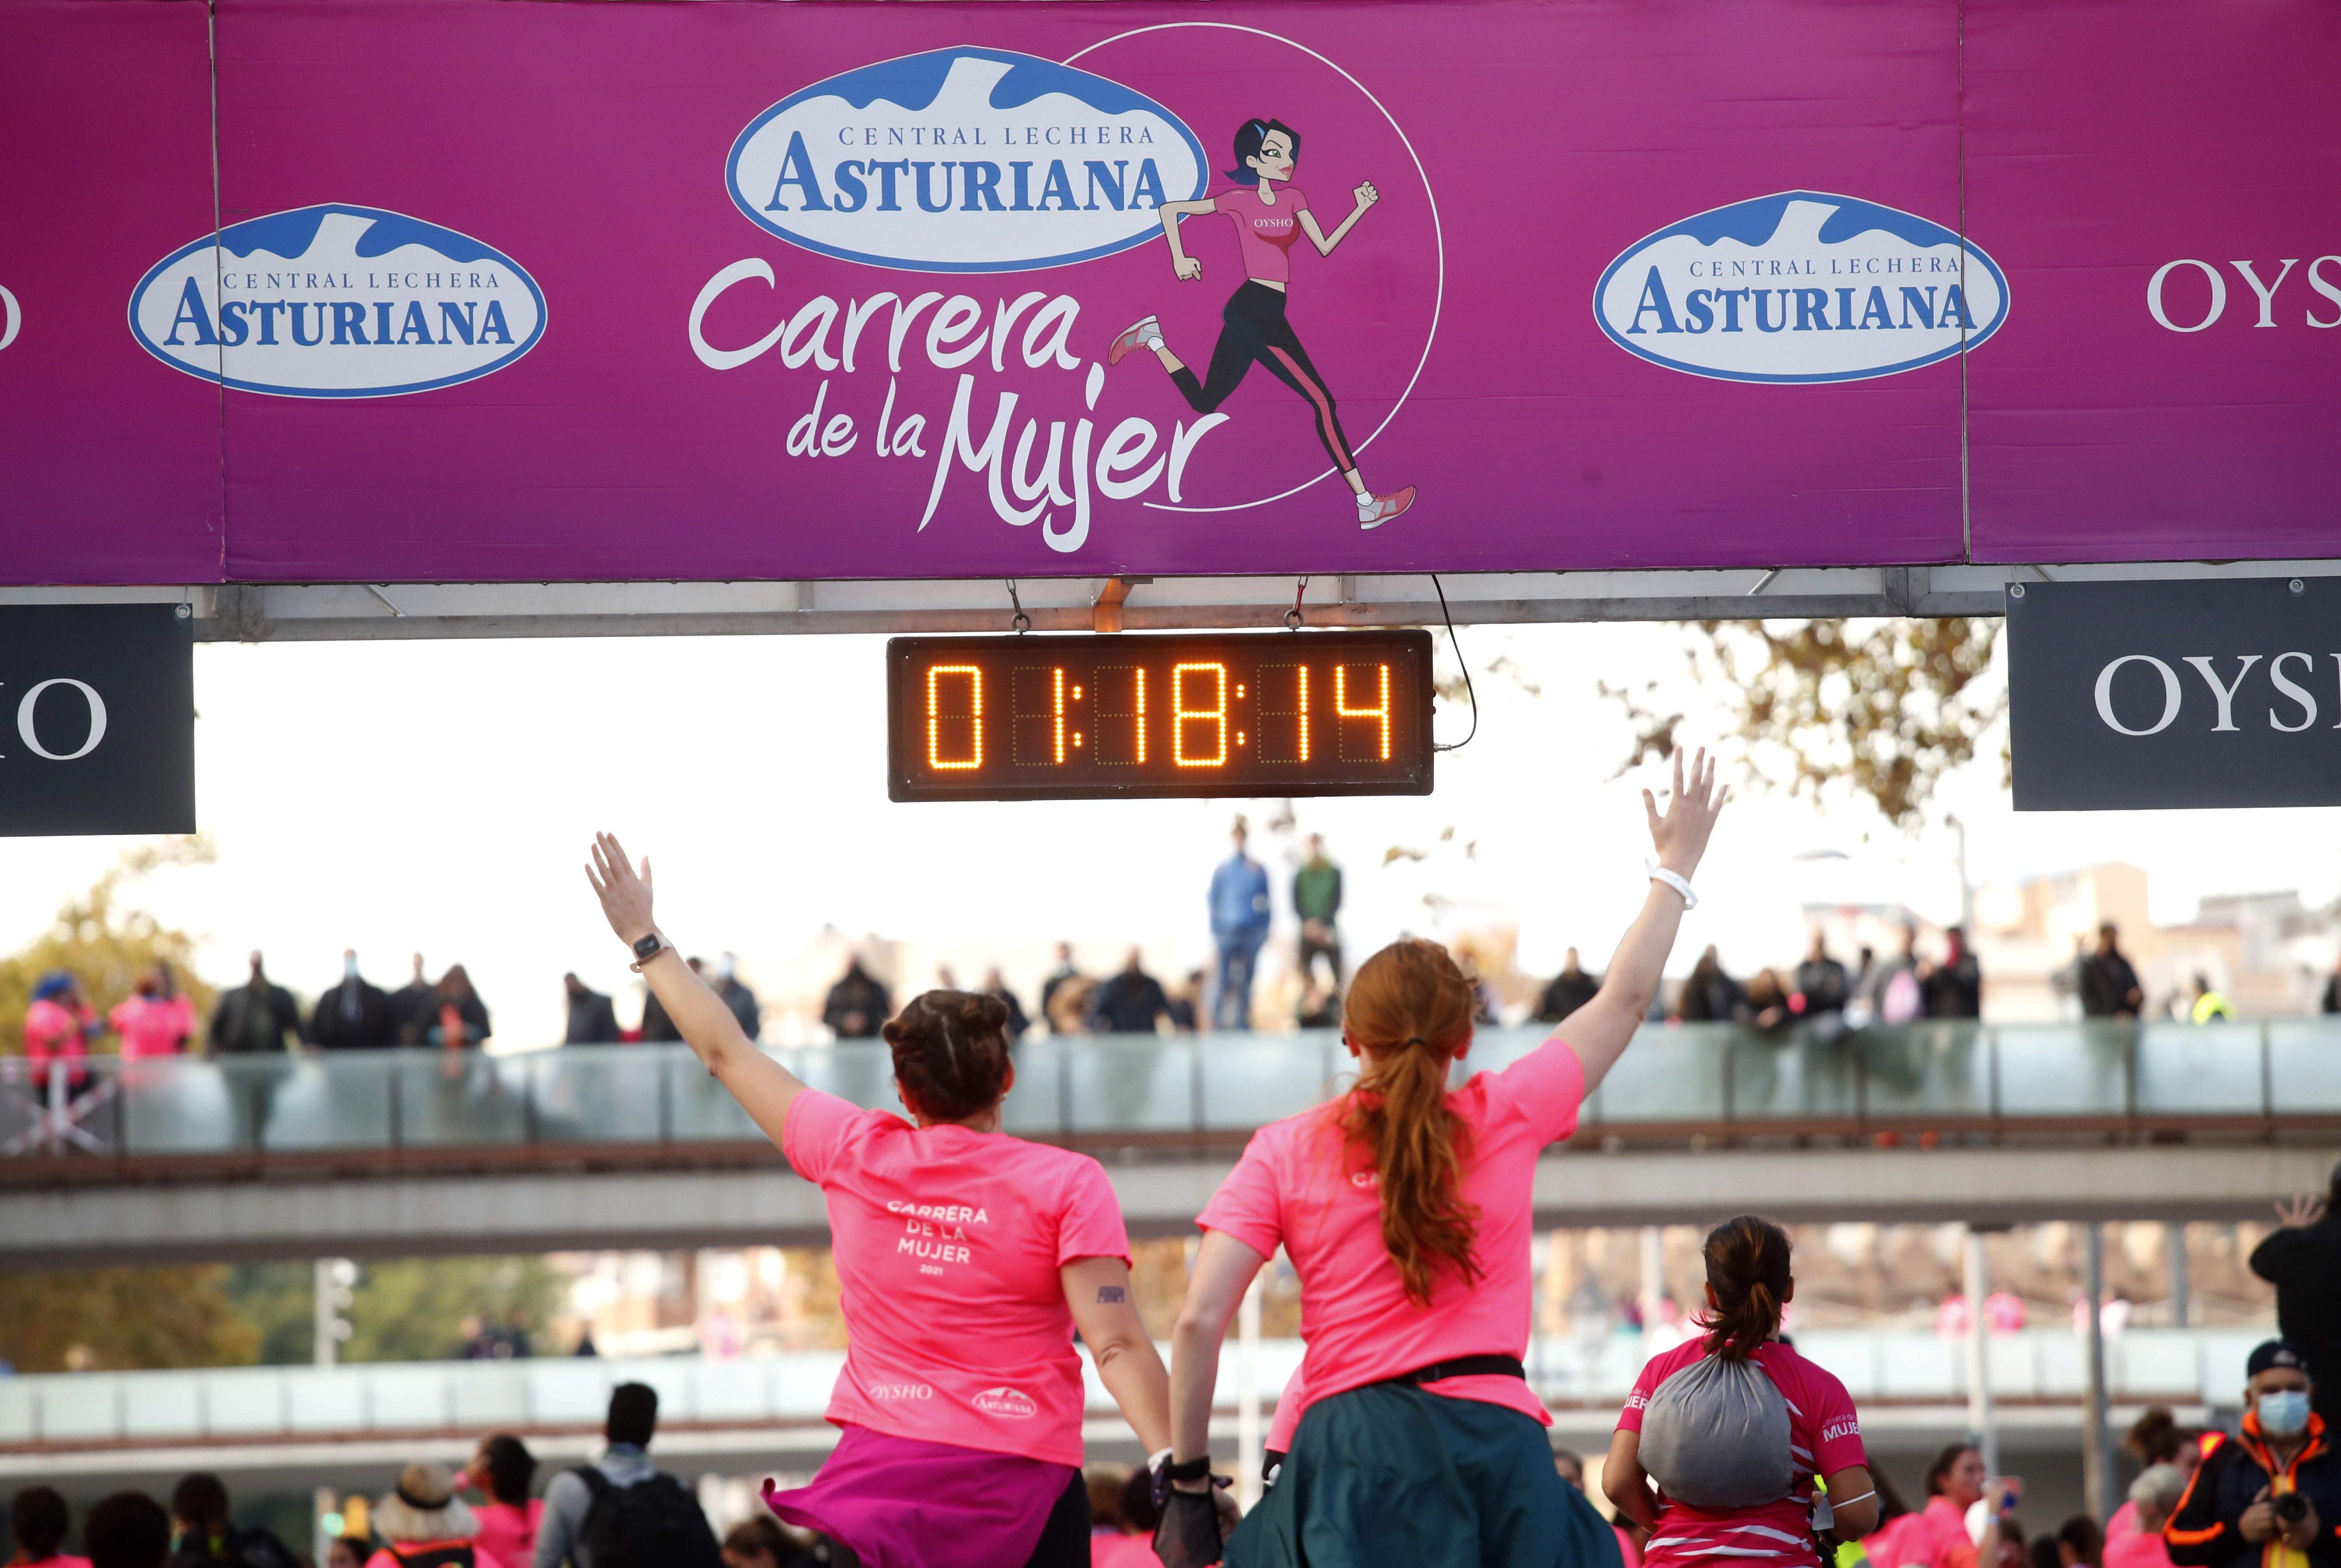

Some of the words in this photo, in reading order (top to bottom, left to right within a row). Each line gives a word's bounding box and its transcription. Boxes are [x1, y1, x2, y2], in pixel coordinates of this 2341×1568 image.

[839, 127, 986, 145] CENTRAL
[1005, 127, 1154, 144] LECHERA
[764, 130, 1161, 213] ASTURIANA
[1254, 218, 1293, 228] OYSHO
[1690, 259, 1816, 276] CENTRAL
[1831, 257, 1960, 274] LECHERA
[224, 273, 354, 289] CENTRAL
[369, 272, 500, 288] LECHERA
[163, 276, 515, 346] ASTURIANA
[1626, 265, 1977, 334] ASTURIANA
[689, 257, 1081, 373] Carrera
[787, 379, 858, 457] de
[876, 376, 926, 457] la
[917, 362, 1230, 553] Mujer
[2095, 652, 2341, 736] OYS
[927, 661, 1391, 770] 01:18:14
[887, 1200, 989, 1224] CARRERA
[906, 1218, 933, 1237] DE
[940, 1226, 967, 1242] LA
[898, 1237, 971, 1264] MUJER
[919, 1264, 944, 1275] 2021
